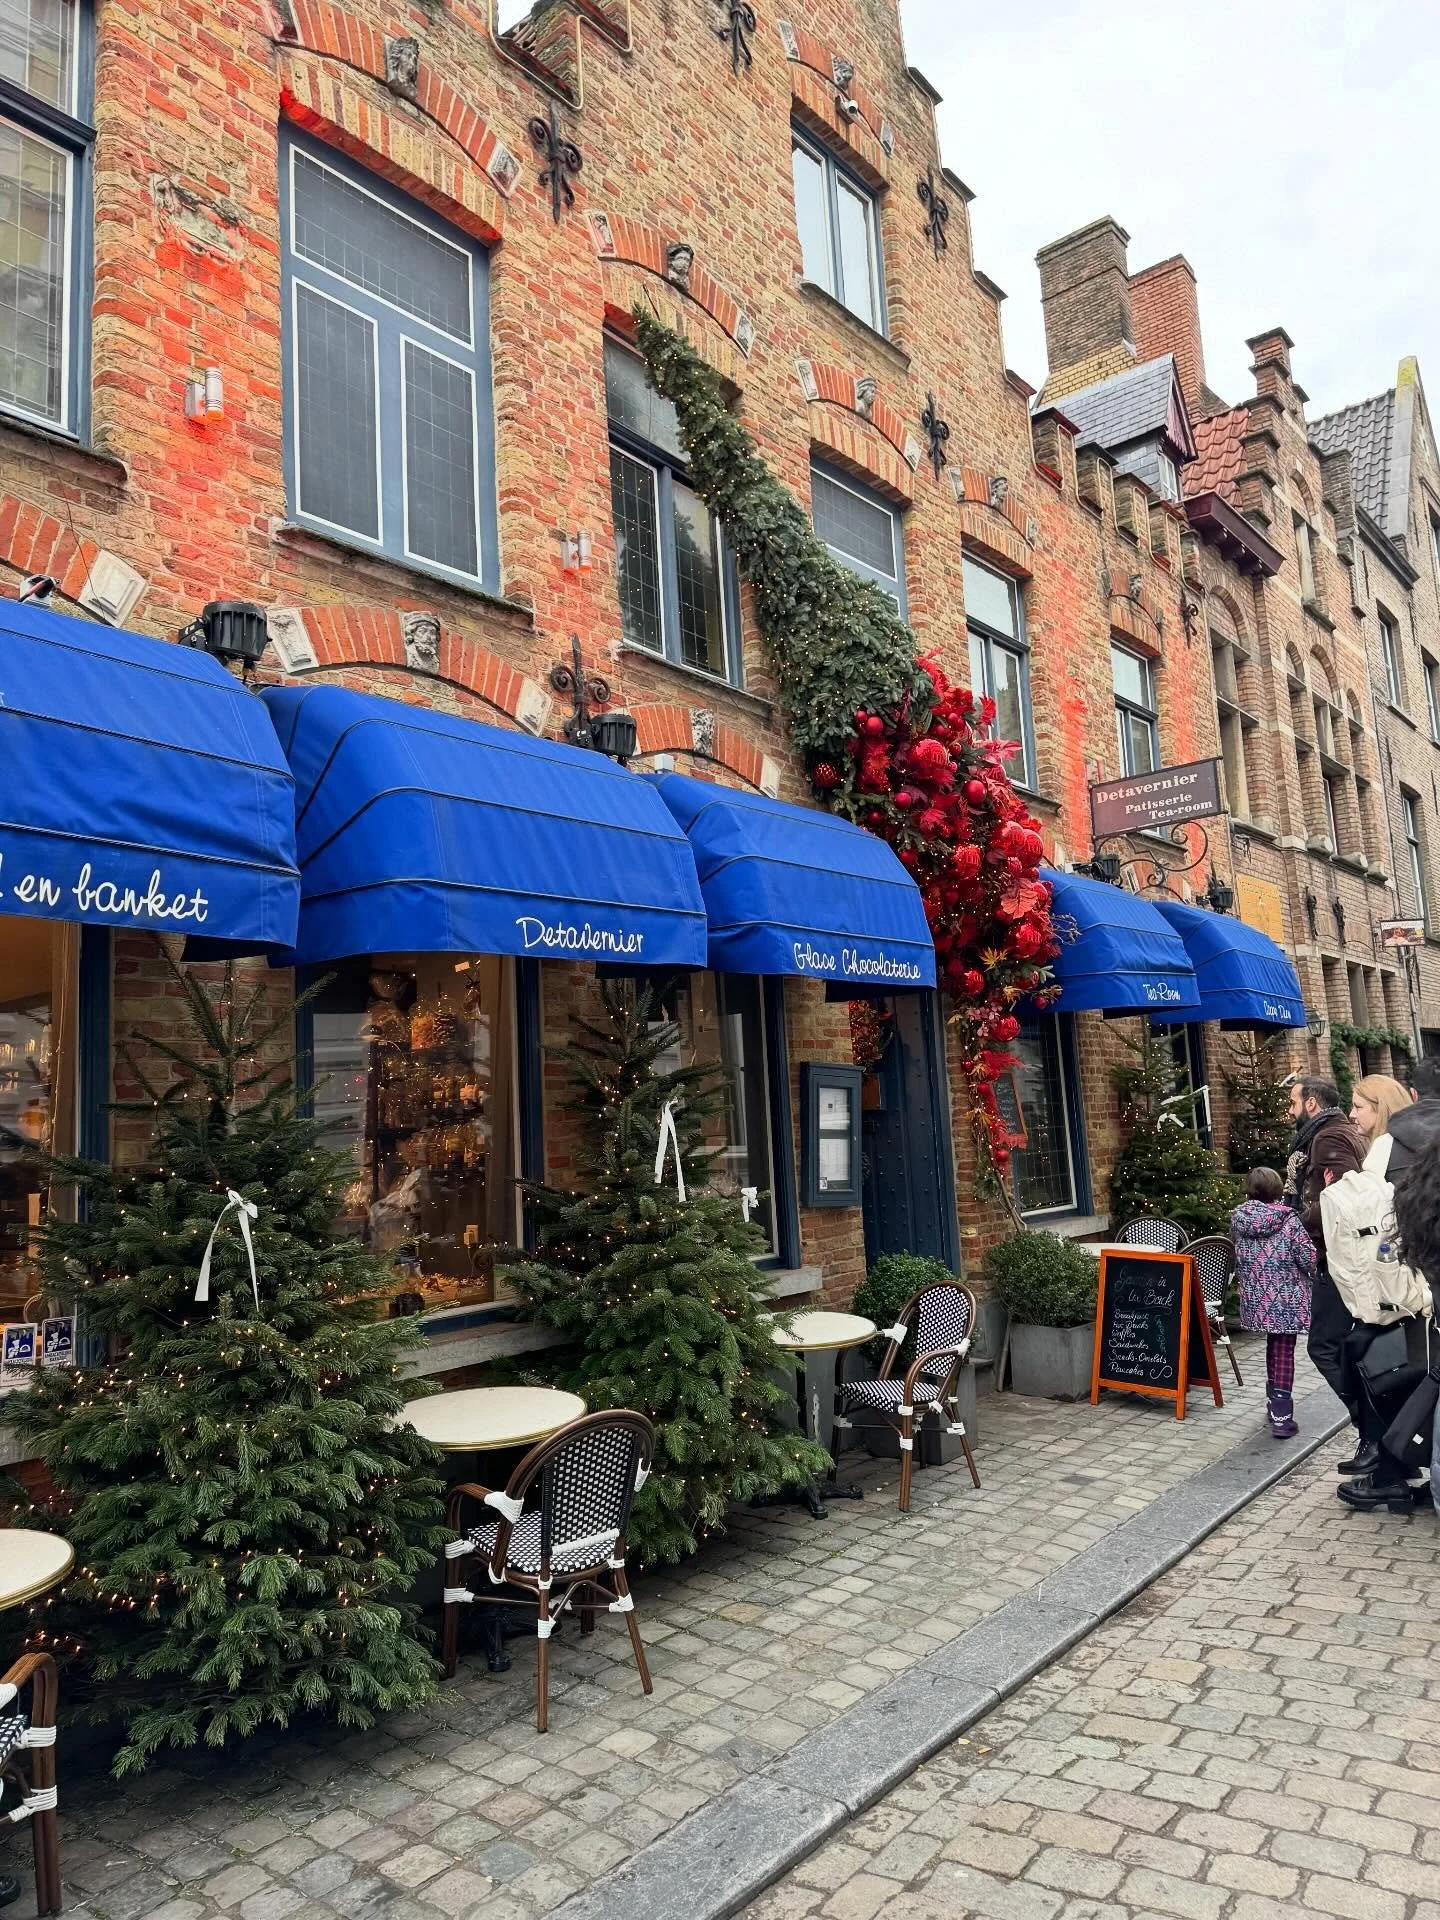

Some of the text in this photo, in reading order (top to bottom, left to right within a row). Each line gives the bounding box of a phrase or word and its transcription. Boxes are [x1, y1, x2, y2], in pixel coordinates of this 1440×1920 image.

[1096, 773, 1198, 804] Detavernier
[1125, 793, 1193, 815] Patisserie
[1149, 800, 1213, 820] Tea-room
[14, 874, 61, 906] en
[72, 863, 209, 922] banket
[516, 917, 643, 953] Detavernier
[842, 949, 921, 980] Chocolaterie
[1143, 1289, 1175, 1306] Back
